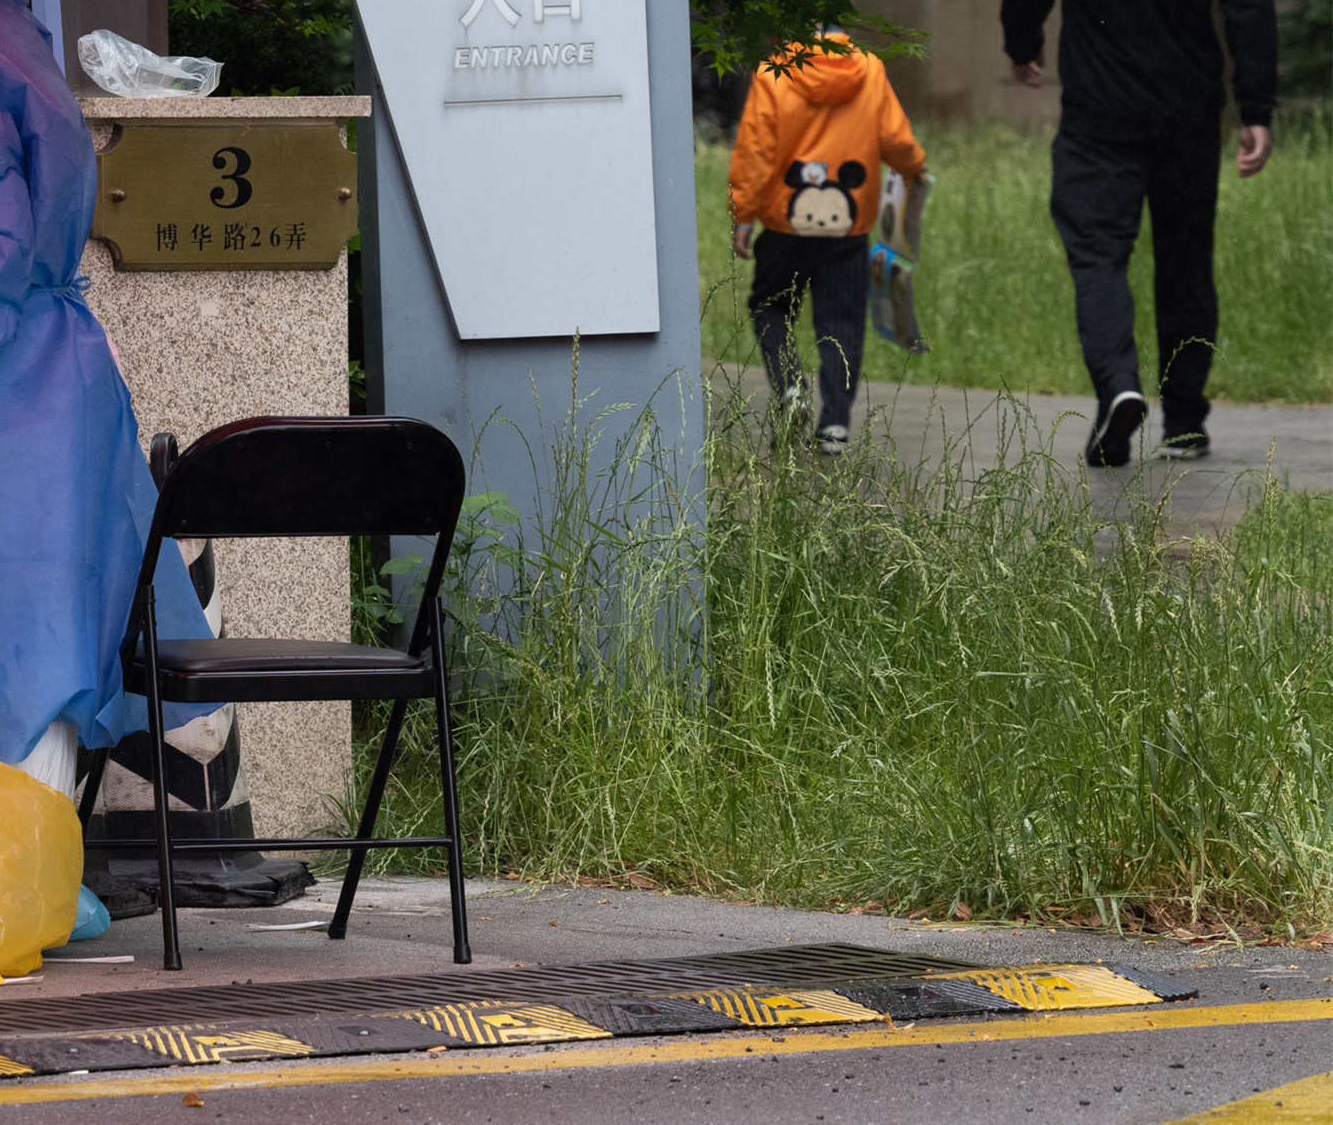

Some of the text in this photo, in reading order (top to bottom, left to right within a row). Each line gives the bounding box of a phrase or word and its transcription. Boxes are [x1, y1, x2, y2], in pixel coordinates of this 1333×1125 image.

[453, 42, 595, 69] ENTRANCE
[209, 146, 253, 209] 3
[156, 222, 307, 252] 博华路26弄
